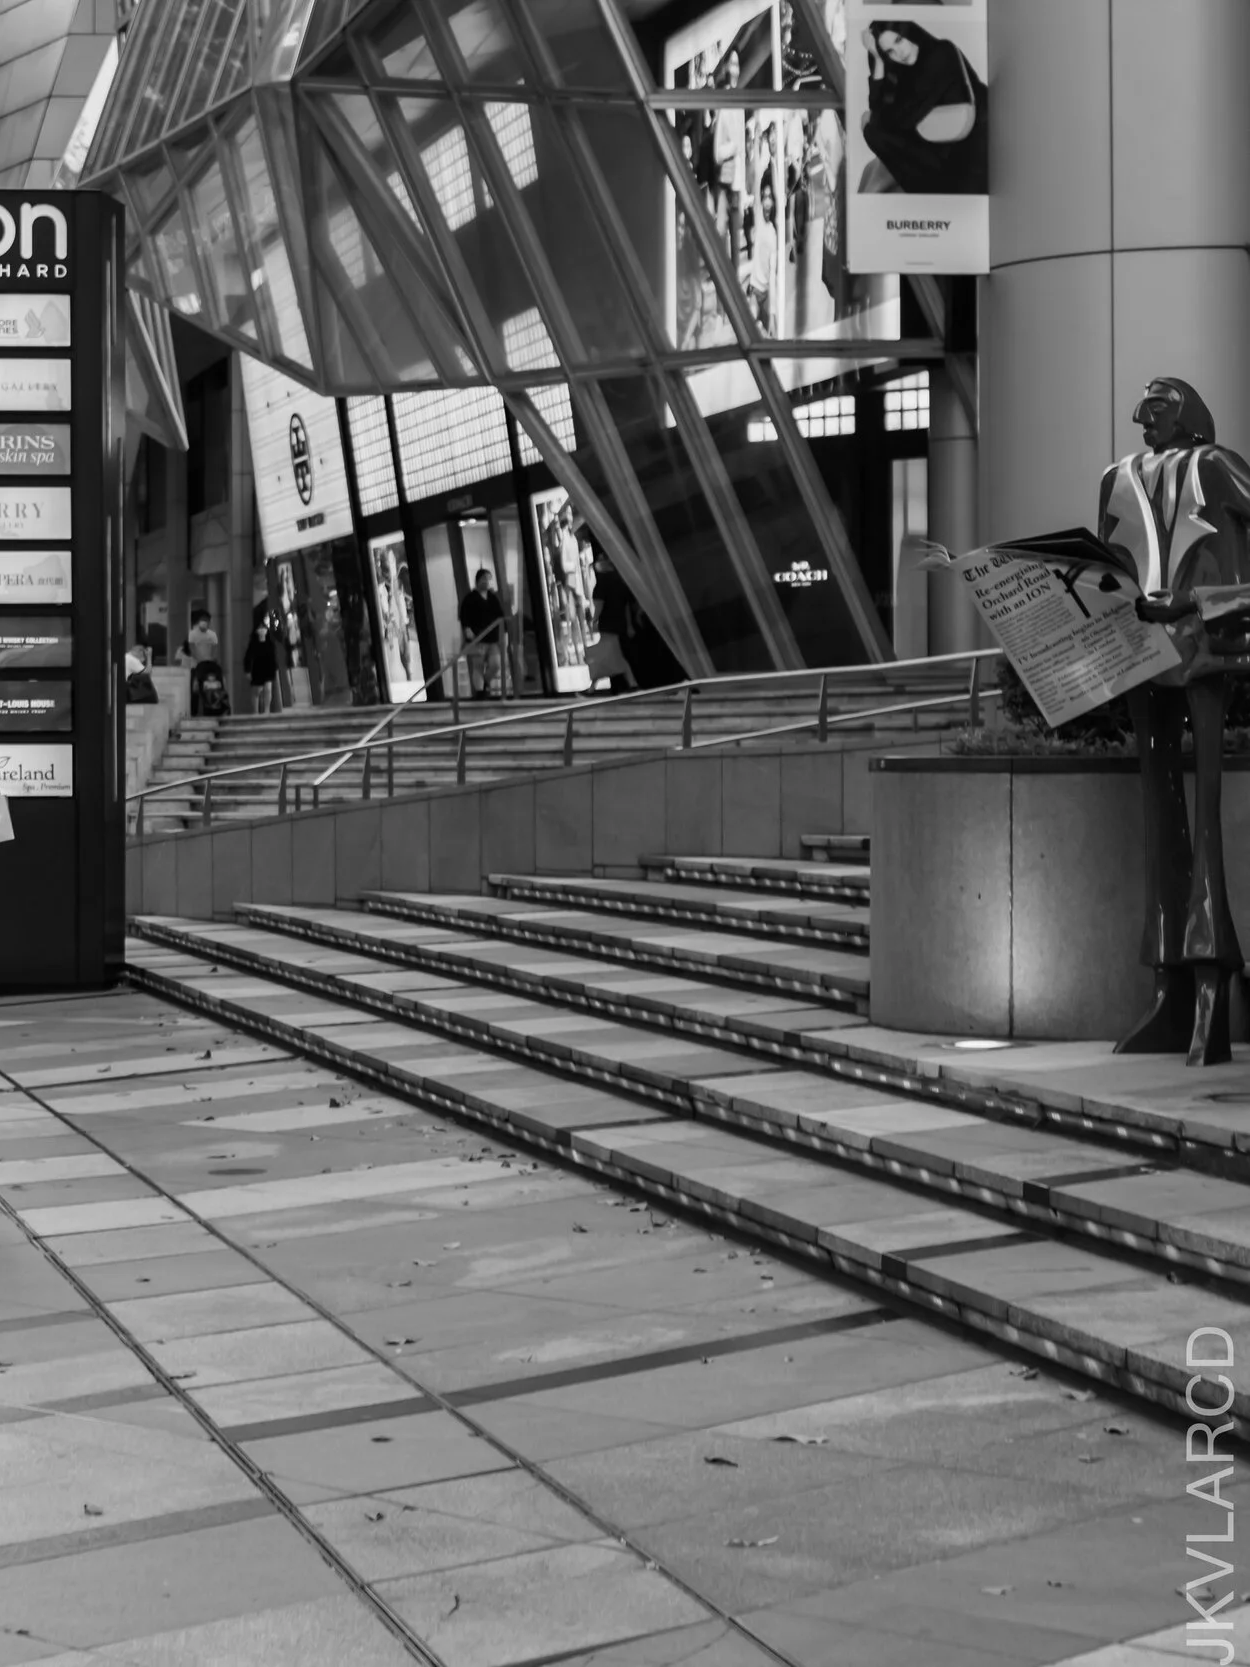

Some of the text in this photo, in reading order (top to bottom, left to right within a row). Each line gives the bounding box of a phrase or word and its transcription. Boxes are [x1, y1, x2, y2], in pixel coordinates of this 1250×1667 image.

[886, 219, 952, 230] BURBERRY
[30, 451, 55, 467] spa
[774, 569, 828, 582] COACH
[962, 563, 990, 583] The
[981, 567, 1051, 610] Orchard Road
[989, 582, 1052, 621] with an ION
